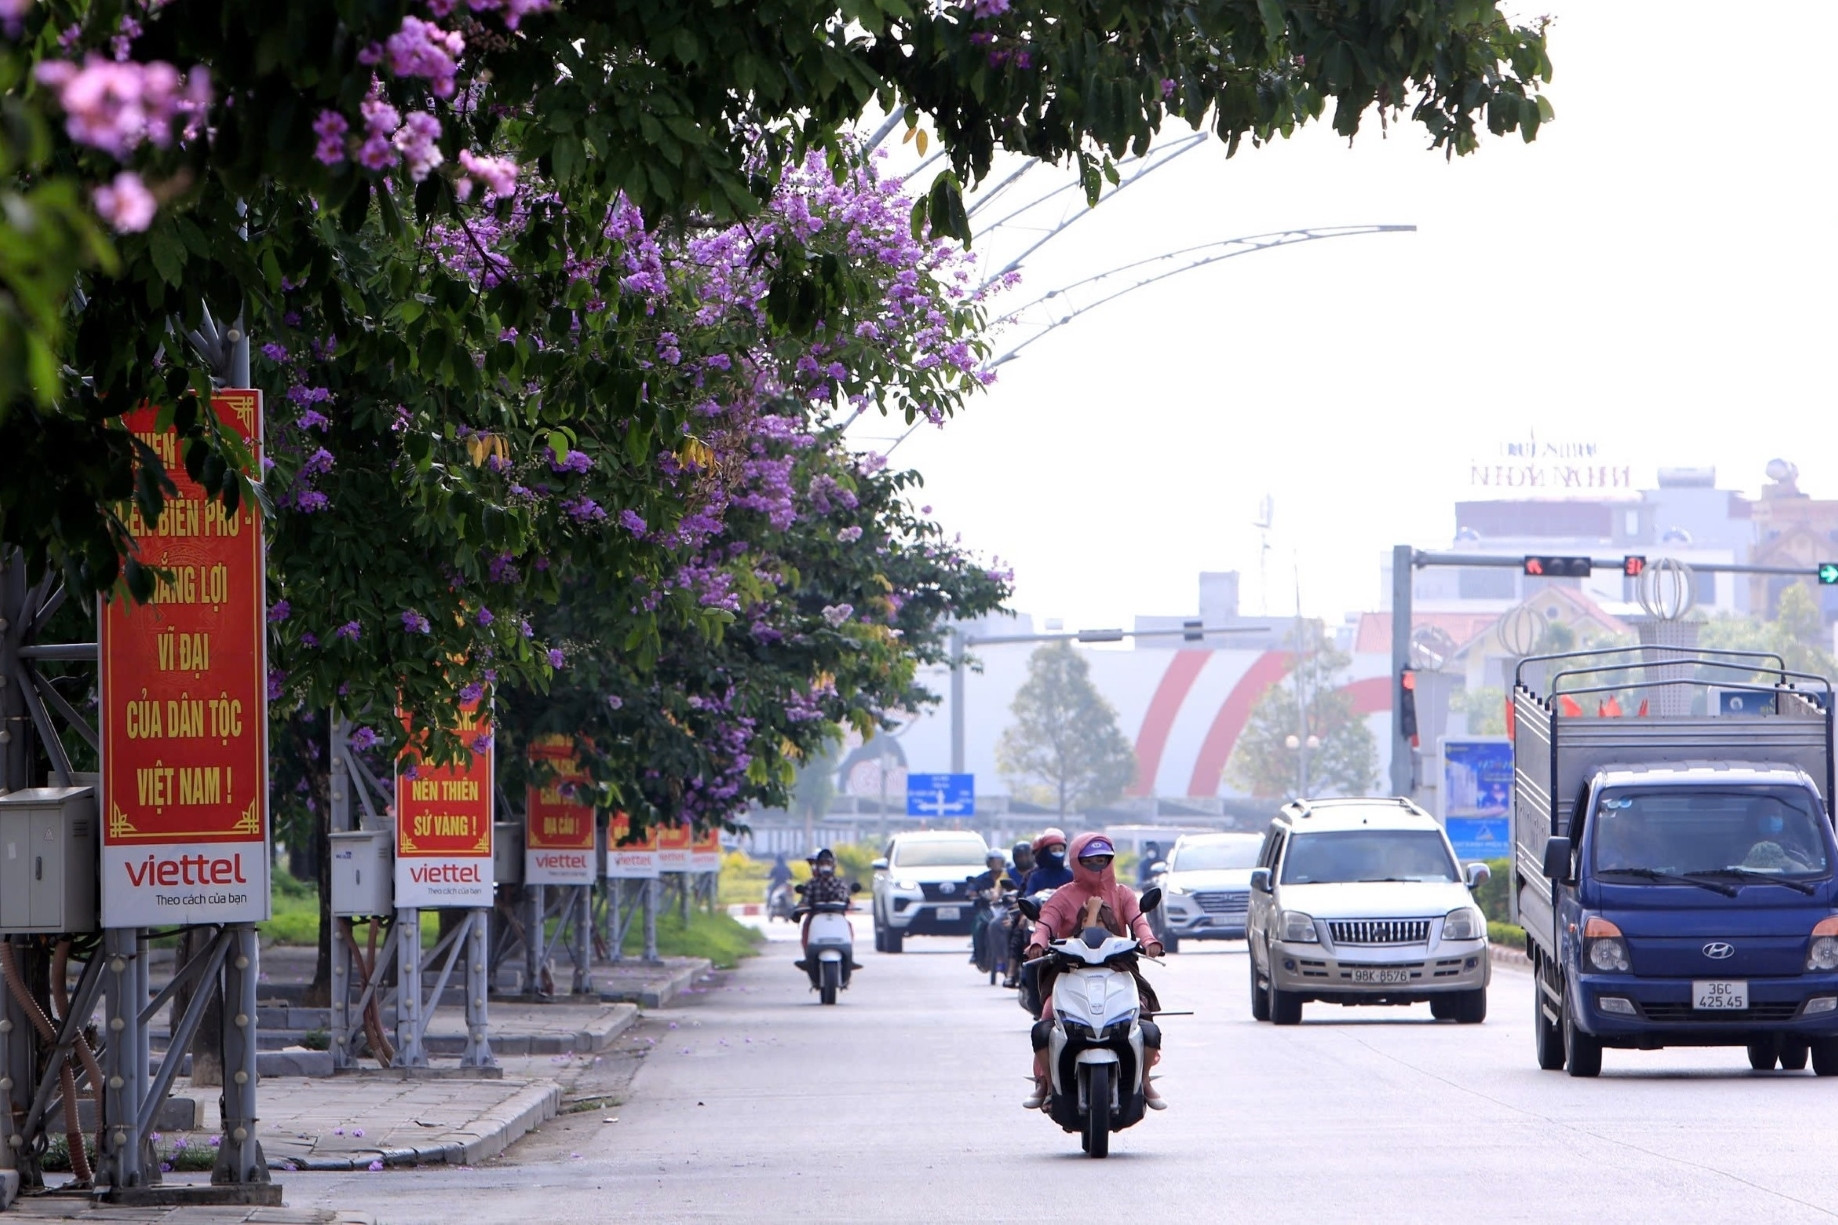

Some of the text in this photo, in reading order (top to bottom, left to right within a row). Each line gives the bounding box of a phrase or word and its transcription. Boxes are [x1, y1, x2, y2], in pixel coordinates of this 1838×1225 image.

[201, 561, 227, 613] LỢI
[157, 625, 209, 679] VĨ ĐẠI
[126, 687, 242, 746] CỦA DÂN TỘC
[136, 759, 232, 815] VIỆT NAM !
[412, 776, 479, 801] NÊN THIÊN
[413, 808, 477, 837] SỬ VÀNG !
[124, 852, 247, 888] viettel
[410, 863, 482, 883] viettel
[535, 853, 587, 869] viettel
[156, 892, 247, 906] Theo cách của bạn
[1699, 996, 1743, 1008] 425.45
[1708, 983, 1732, 995] 36C
